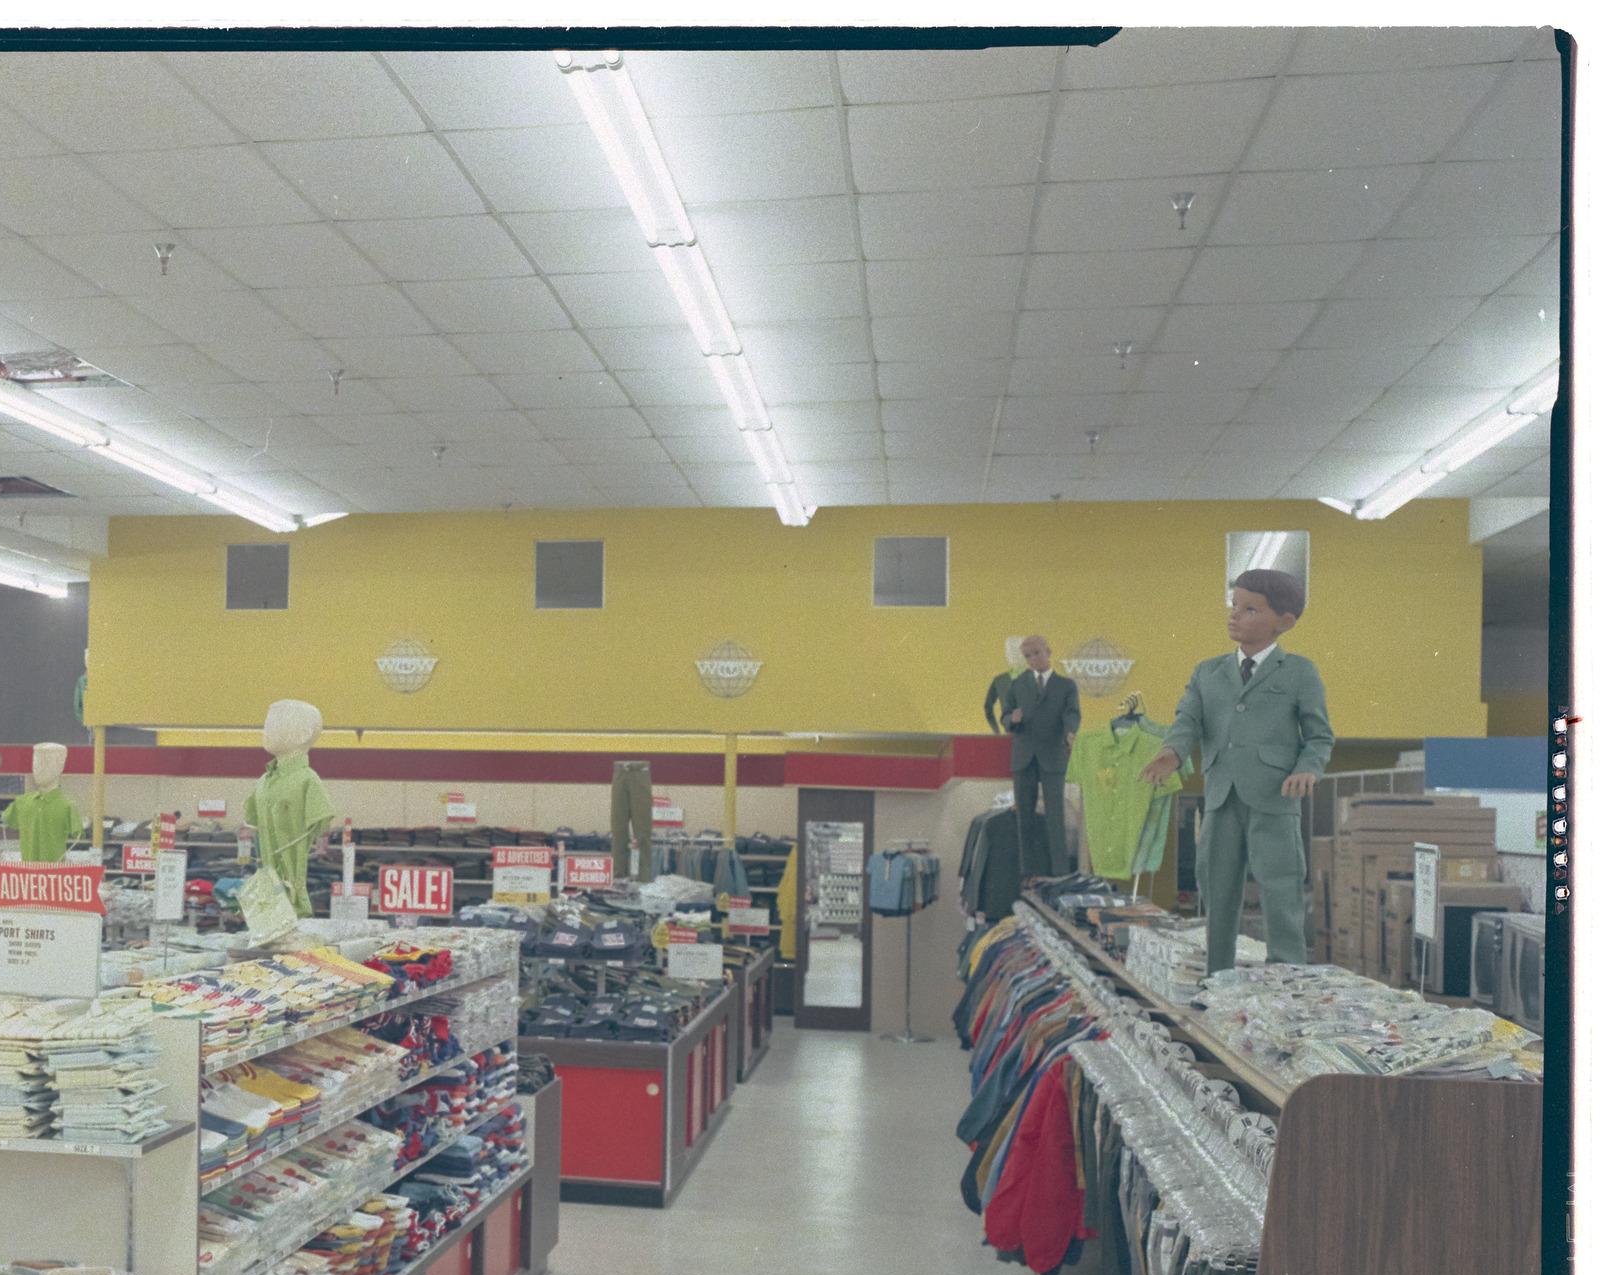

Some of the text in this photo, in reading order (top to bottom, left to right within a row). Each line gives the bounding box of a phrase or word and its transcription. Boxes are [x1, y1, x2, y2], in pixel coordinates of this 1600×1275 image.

[694, 660, 763, 677] WOW
[1059, 659, 1135, 677] WOW
[0, 872, 92, 902] ADVERTISED
[384, 869, 448, 911] SALE!
[24, 928, 55, 941] SHIRTS
[1201, 1085, 1212, 1095] 14
[1222, 1086, 1234, 1096] 14
[1240, 1116, 1252, 1128] 16
